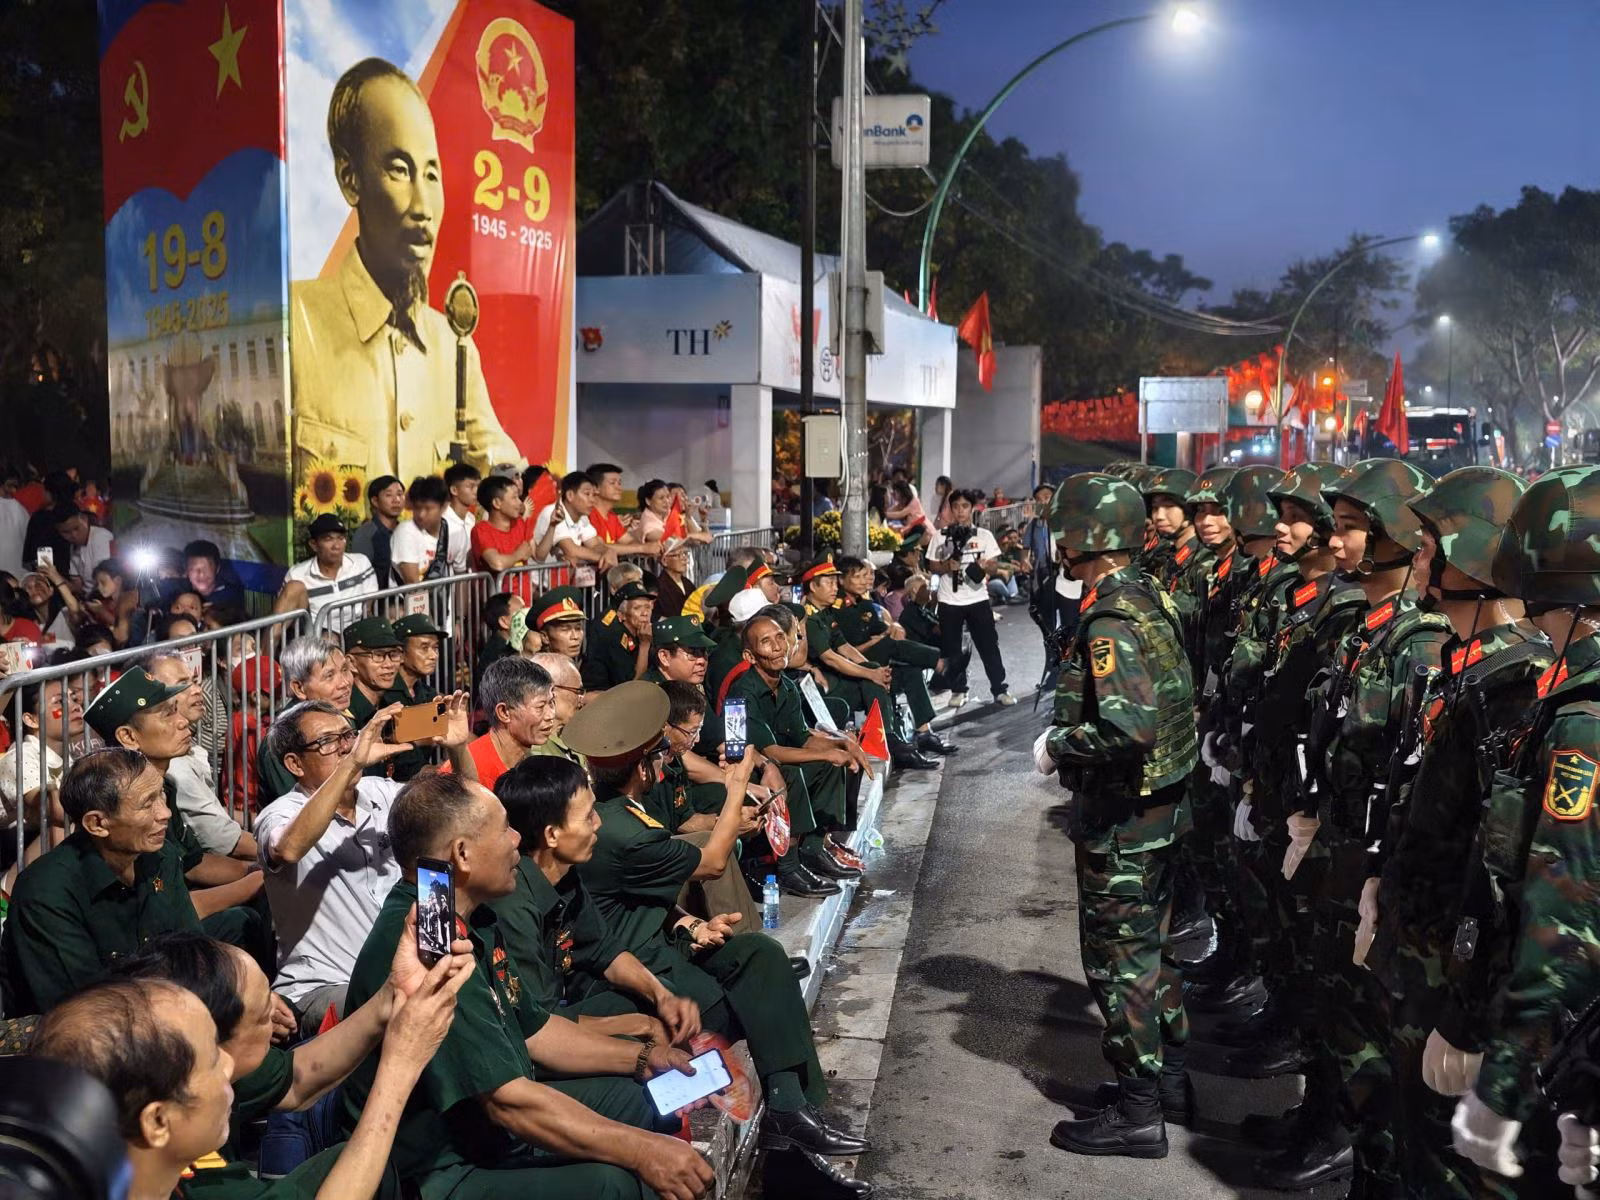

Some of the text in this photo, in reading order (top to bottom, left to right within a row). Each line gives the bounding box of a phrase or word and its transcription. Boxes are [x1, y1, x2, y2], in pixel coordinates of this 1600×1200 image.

[474, 150, 550, 222] 2-9
[144, 211, 227, 294] 19-8
[472, 213, 507, 239] 1945
[520, 226, 552, 250] 2025
[666, 329, 712, 355] TH
